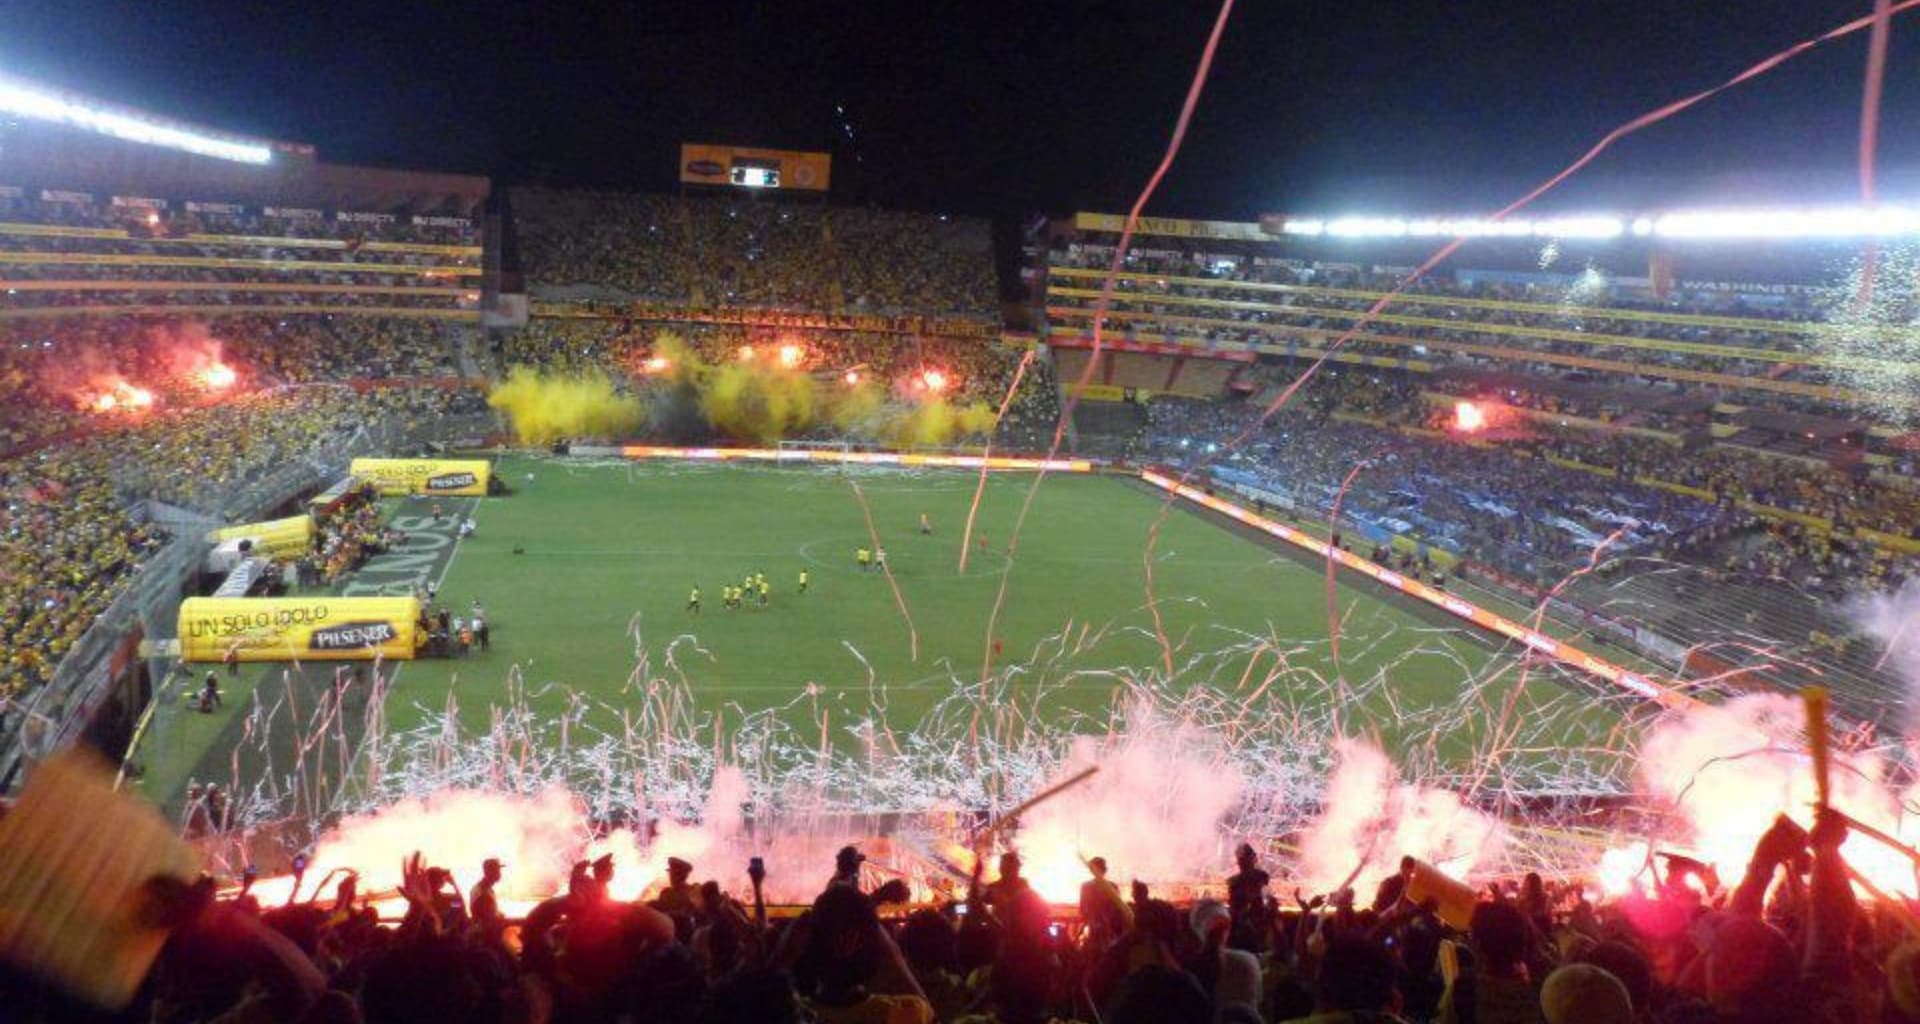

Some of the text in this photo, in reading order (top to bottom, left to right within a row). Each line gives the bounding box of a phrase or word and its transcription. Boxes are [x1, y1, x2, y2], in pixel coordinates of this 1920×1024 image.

[189, 616, 219, 638] UN
[222, 611, 270, 634] SOLO
[317, 624, 389, 649] PILSENER
